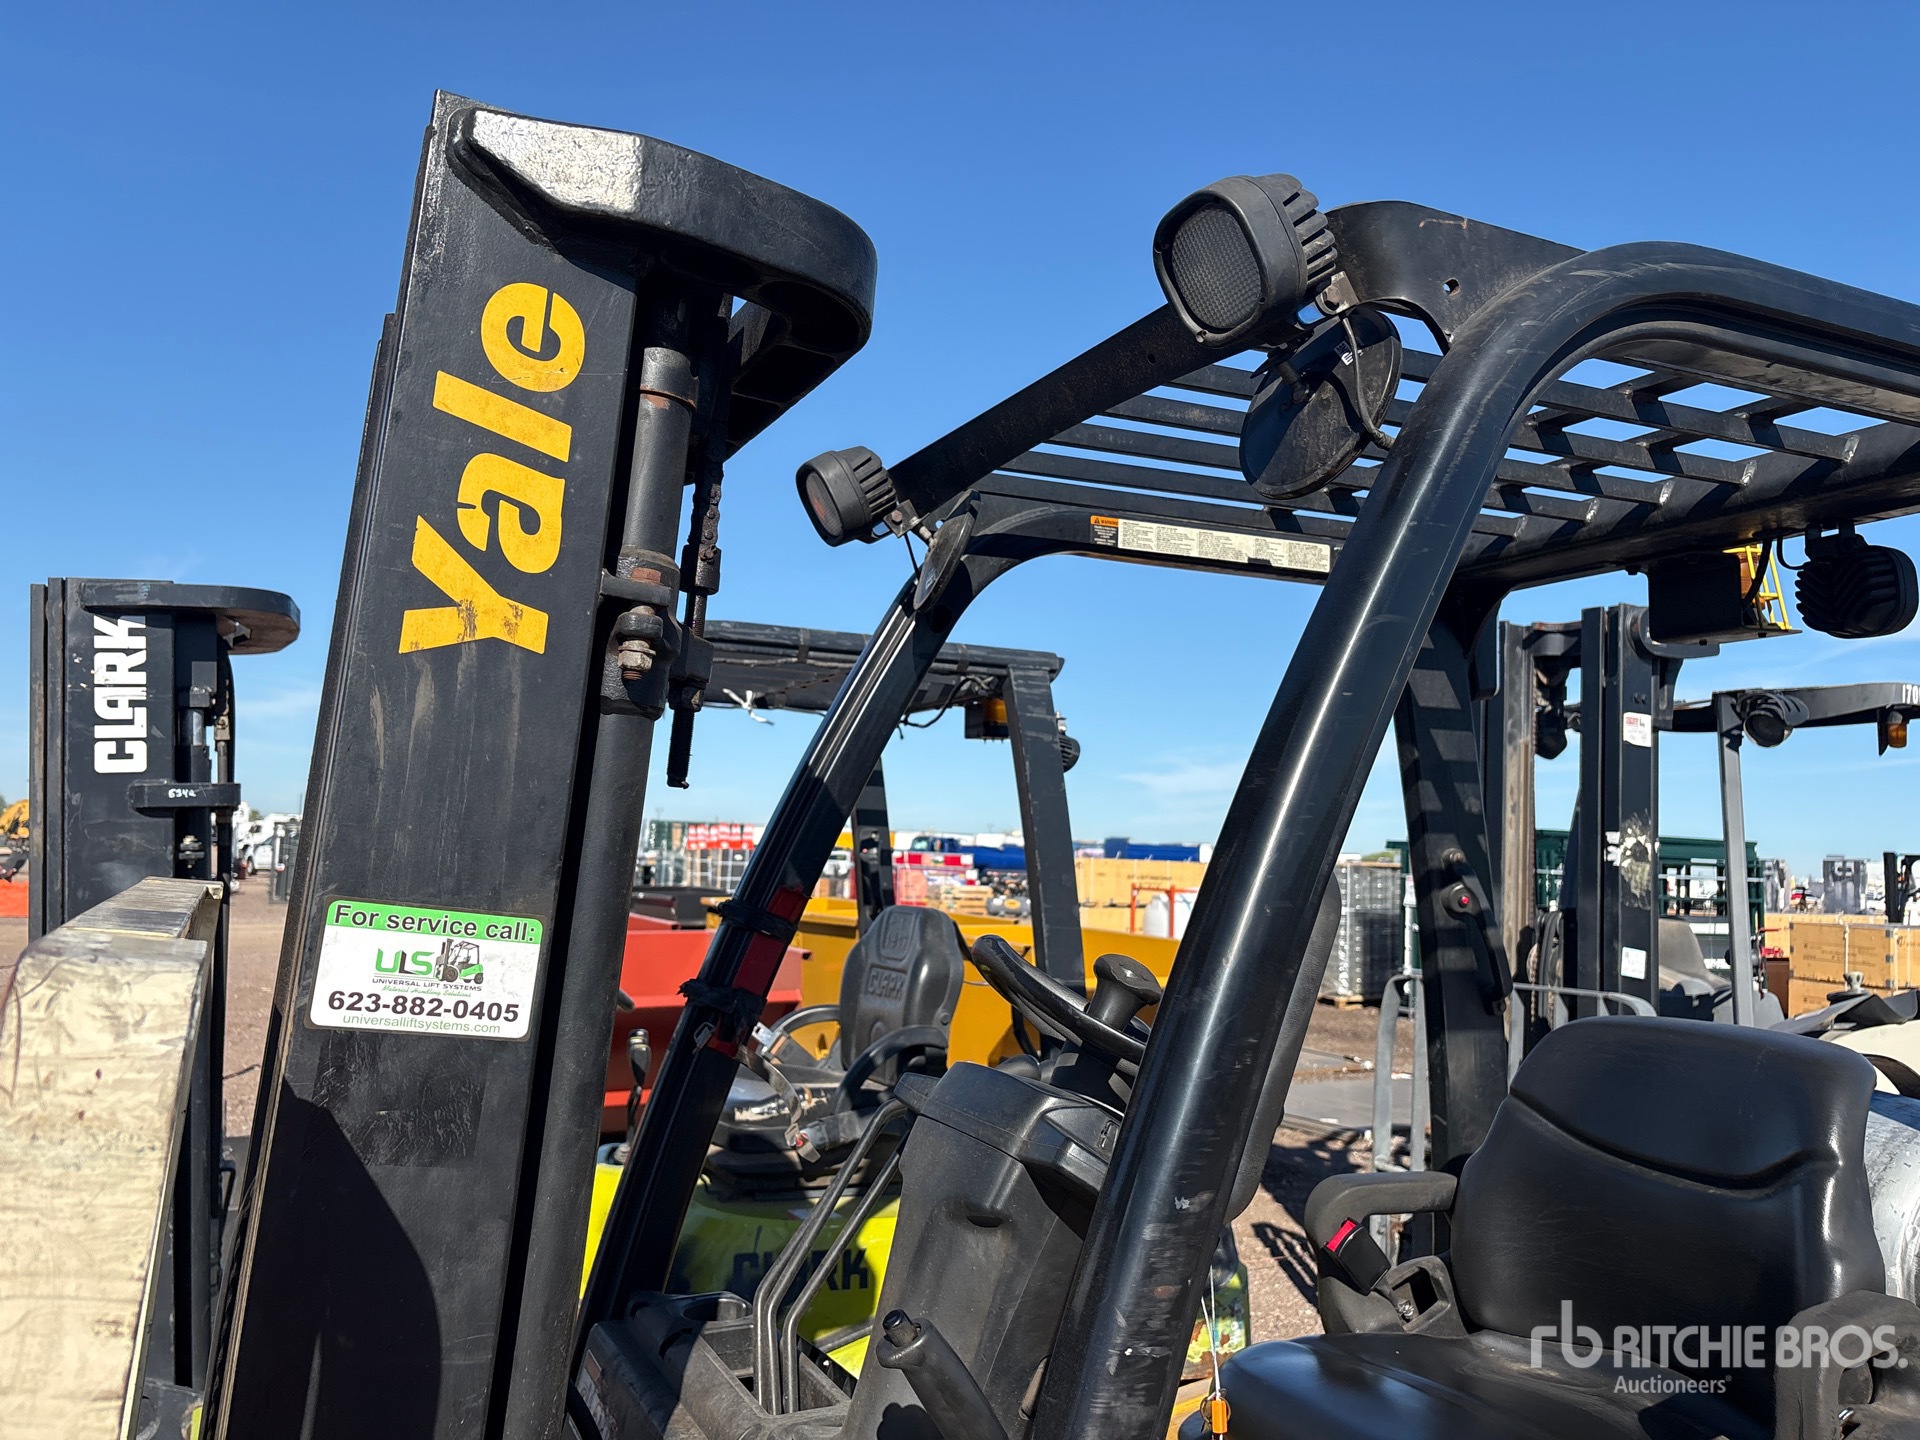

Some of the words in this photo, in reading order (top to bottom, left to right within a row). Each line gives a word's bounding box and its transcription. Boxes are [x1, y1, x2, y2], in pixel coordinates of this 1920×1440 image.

[398, 282, 586, 655] Yale
[94, 614, 148, 774] CLARK
[334, 904, 380, 926] For
[386, 912, 477, 937] service
[485, 921, 536, 942] call:
[375, 947, 435, 976] ULS
[372, 978, 421, 987] UNIVERSAL
[443, 983, 483, 992] SYSTEMS
[327, 990, 520, 1023] 623-882-0405
[342, 1013, 501, 1034] universalliftsystems.com
